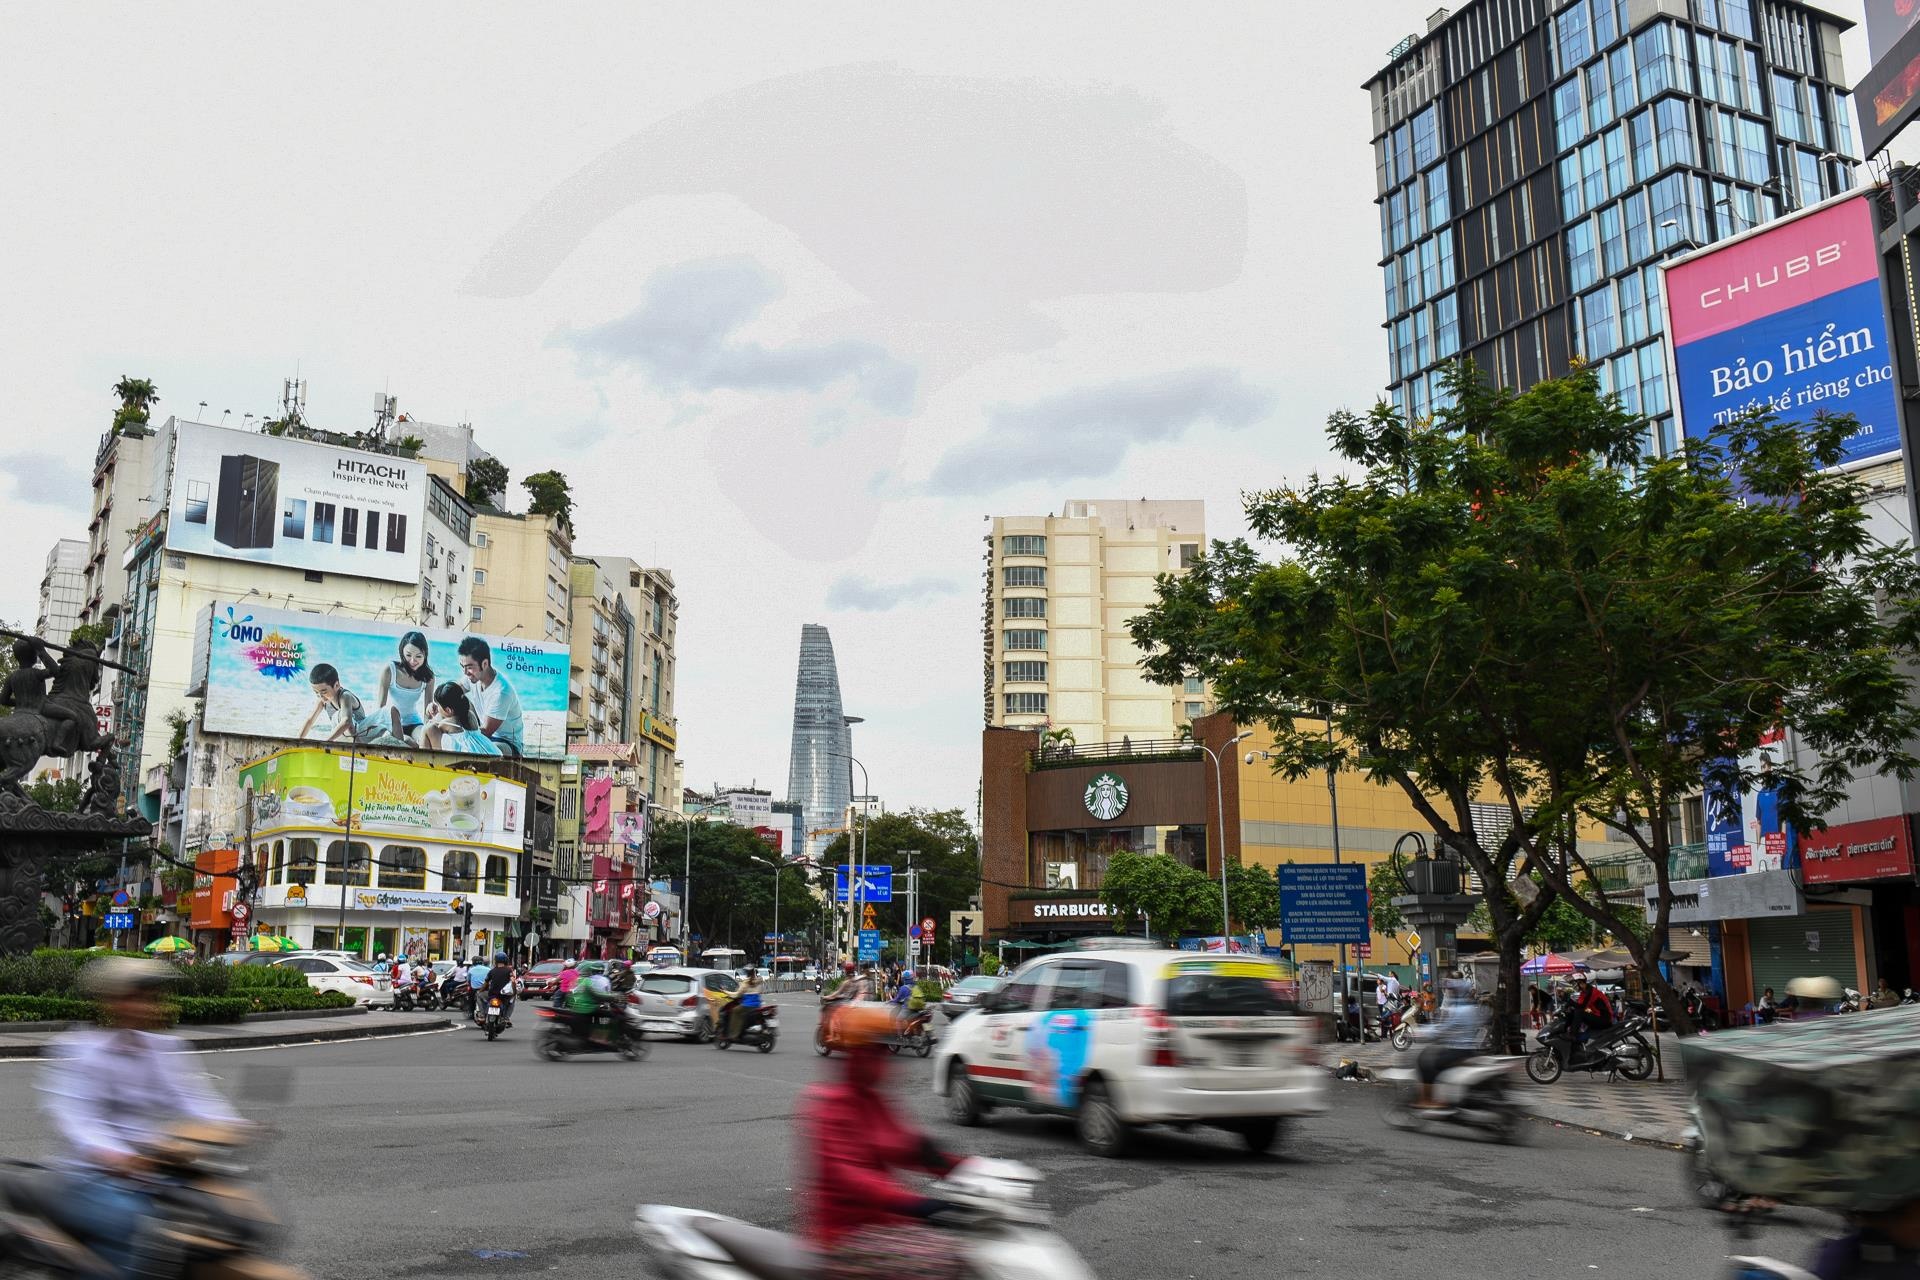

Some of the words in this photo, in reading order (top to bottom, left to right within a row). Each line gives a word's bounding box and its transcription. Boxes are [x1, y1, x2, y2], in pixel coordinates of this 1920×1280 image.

[1700, 243, 1841, 309] CHUBB
[1709, 357, 1773, 397] Bảo
[1781, 322, 1875, 375] hiểm
[1768, 387, 1792, 414] kế
[1796, 376, 1851, 407] riêng
[1855, 364, 1893, 388] cho
[337, 459, 406, 480] HITACHI
[332, 471, 366, 484] Inspire
[368, 478, 384, 486] the
[386, 480, 409, 490] Next
[230, 624, 262, 643] OMO
[516, 662, 534, 671] bên
[538, 664, 562, 674] nhau
[1847, 843, 1869, 858] pierre
[1869, 838, 1892, 852] cardin
[377, 892, 402, 905] Garden
